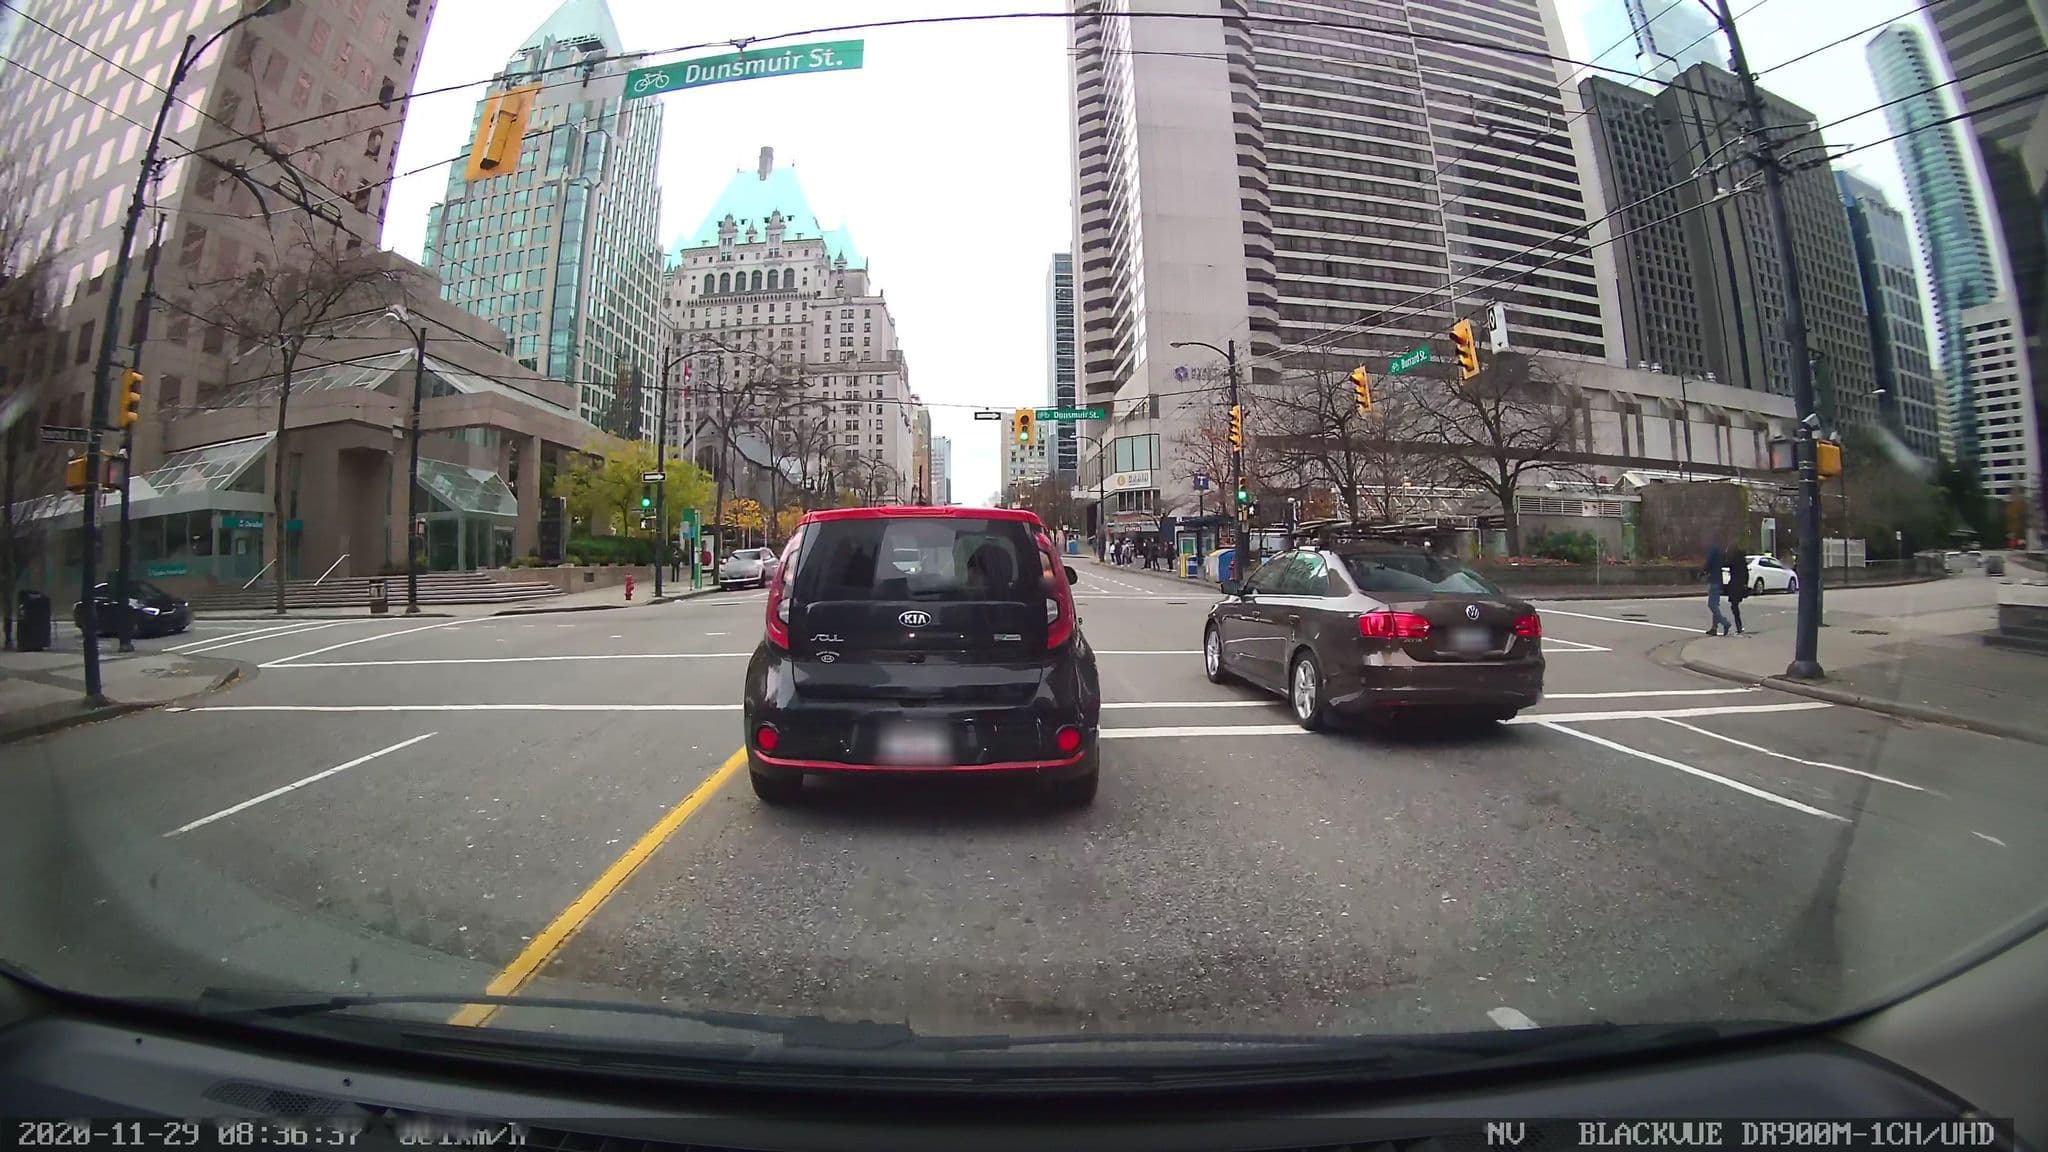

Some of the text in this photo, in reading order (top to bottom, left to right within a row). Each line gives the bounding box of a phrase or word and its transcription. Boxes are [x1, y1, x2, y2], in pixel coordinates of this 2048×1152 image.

[685, 48, 843, 84] Dunsmuir St.
[1053, 410, 1100, 419] Dunsmuir St.
[903, 613, 927, 625] KIA
